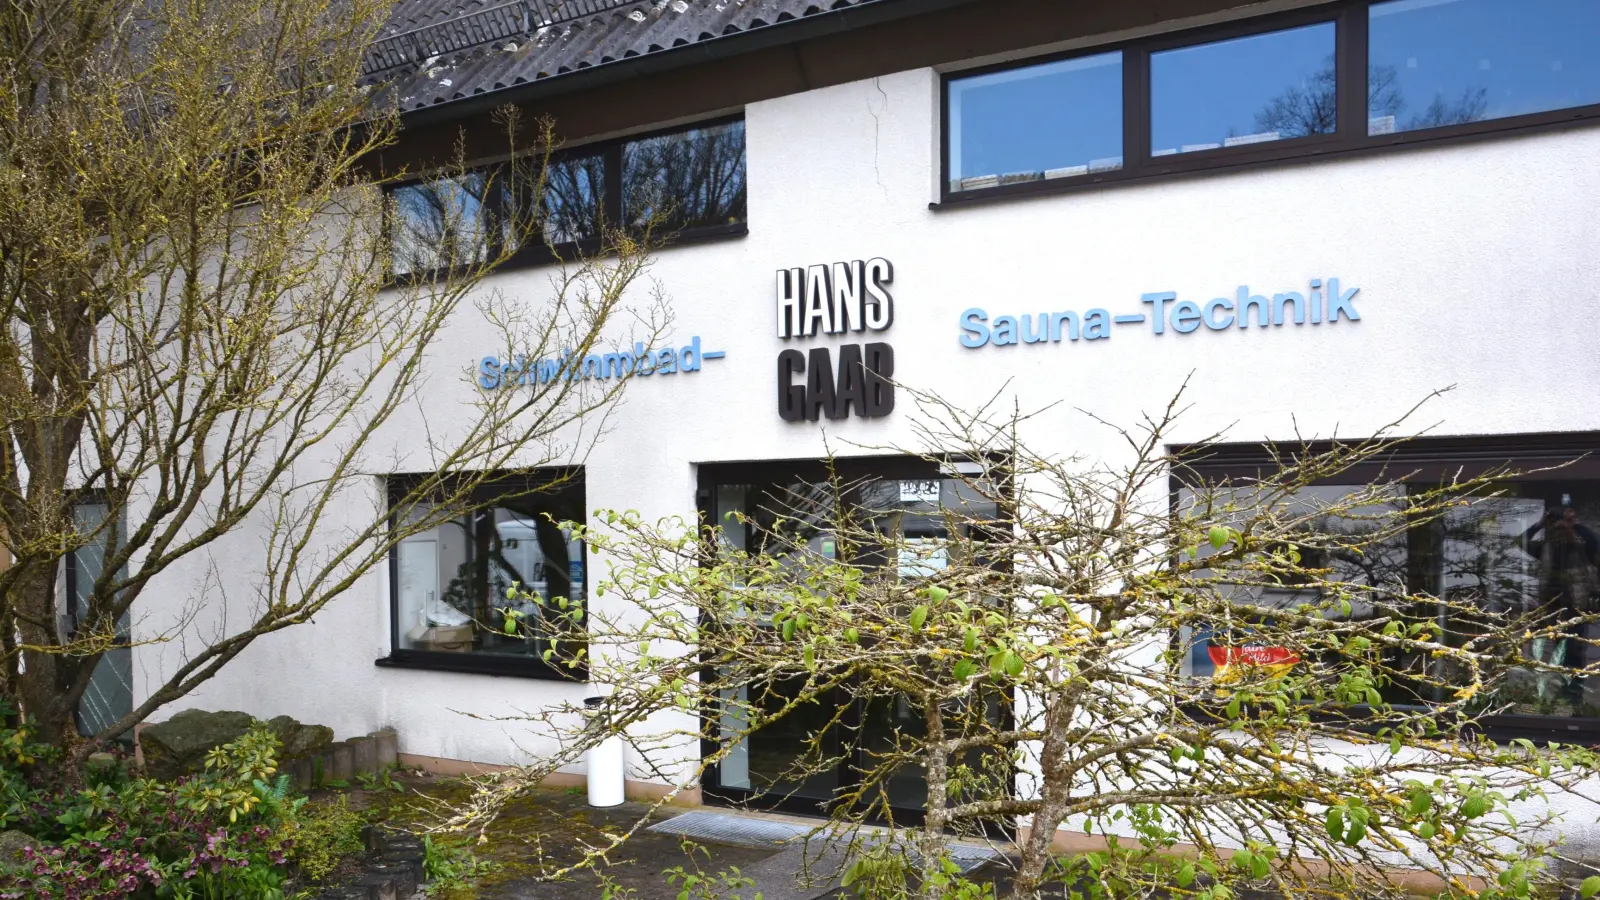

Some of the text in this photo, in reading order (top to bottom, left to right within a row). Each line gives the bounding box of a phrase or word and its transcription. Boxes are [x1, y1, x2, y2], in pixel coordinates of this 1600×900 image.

[776, 256, 894, 339] HANS
[959, 277, 1361, 348] Sauna-Technik
[777, 341, 895, 421] GAAB
